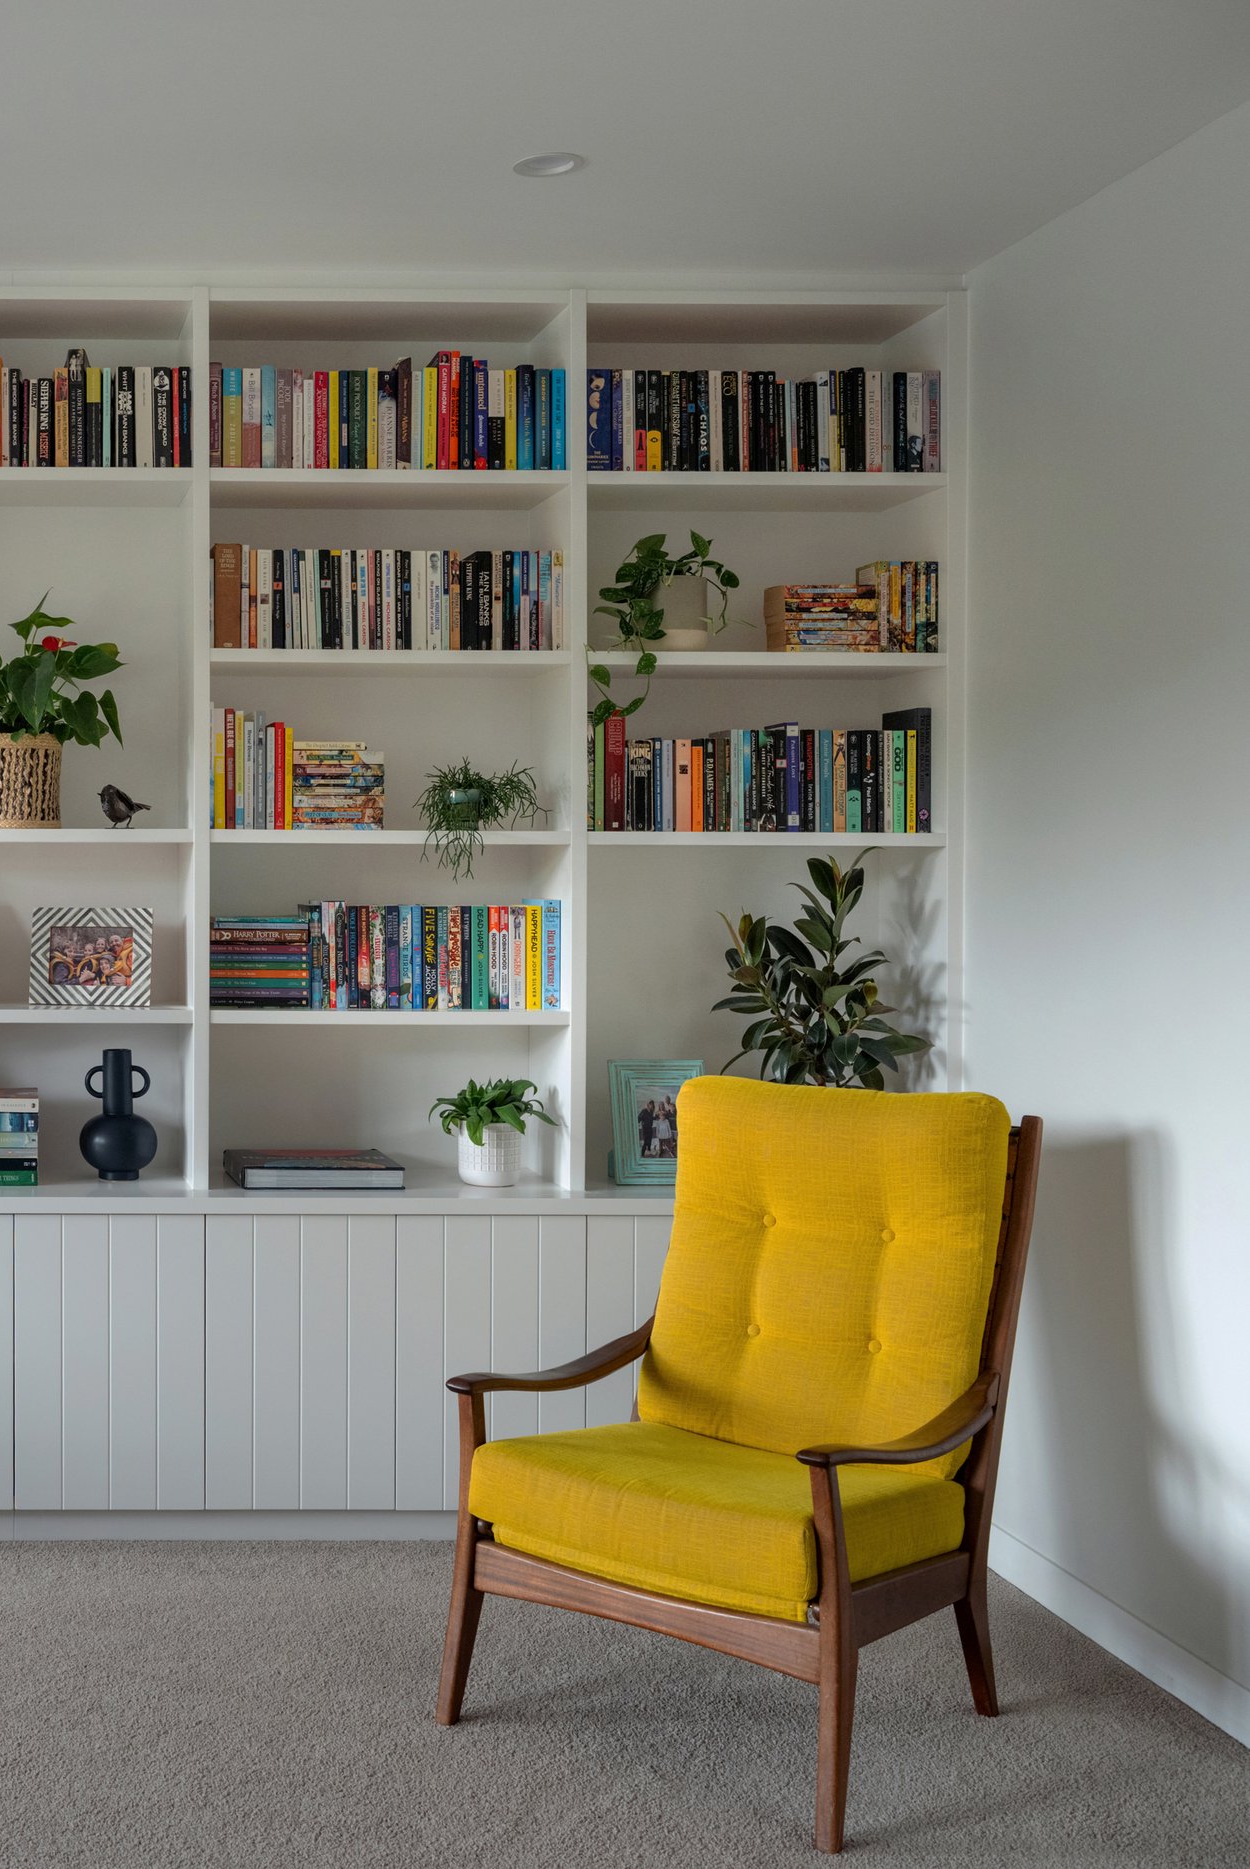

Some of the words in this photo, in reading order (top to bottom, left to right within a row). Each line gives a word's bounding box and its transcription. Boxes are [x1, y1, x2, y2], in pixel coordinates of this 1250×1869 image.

[40, 380, 49, 411] STEPHEN
[211, 382, 219, 399] Mitch
[478, 372, 486, 410] untamed
[723, 375, 732, 395] ECO
[40, 411, 49, 430] KING
[211, 400, 219, 421] Albom
[40, 432, 48, 459] MISERY
[376, 577, 381, 585] ON
[227, 738, 234, 748] OK
[608, 720, 622, 756] CRUMP
[425, 908, 435, 931] FIVE
[425, 933, 436, 963] SURVIVE
